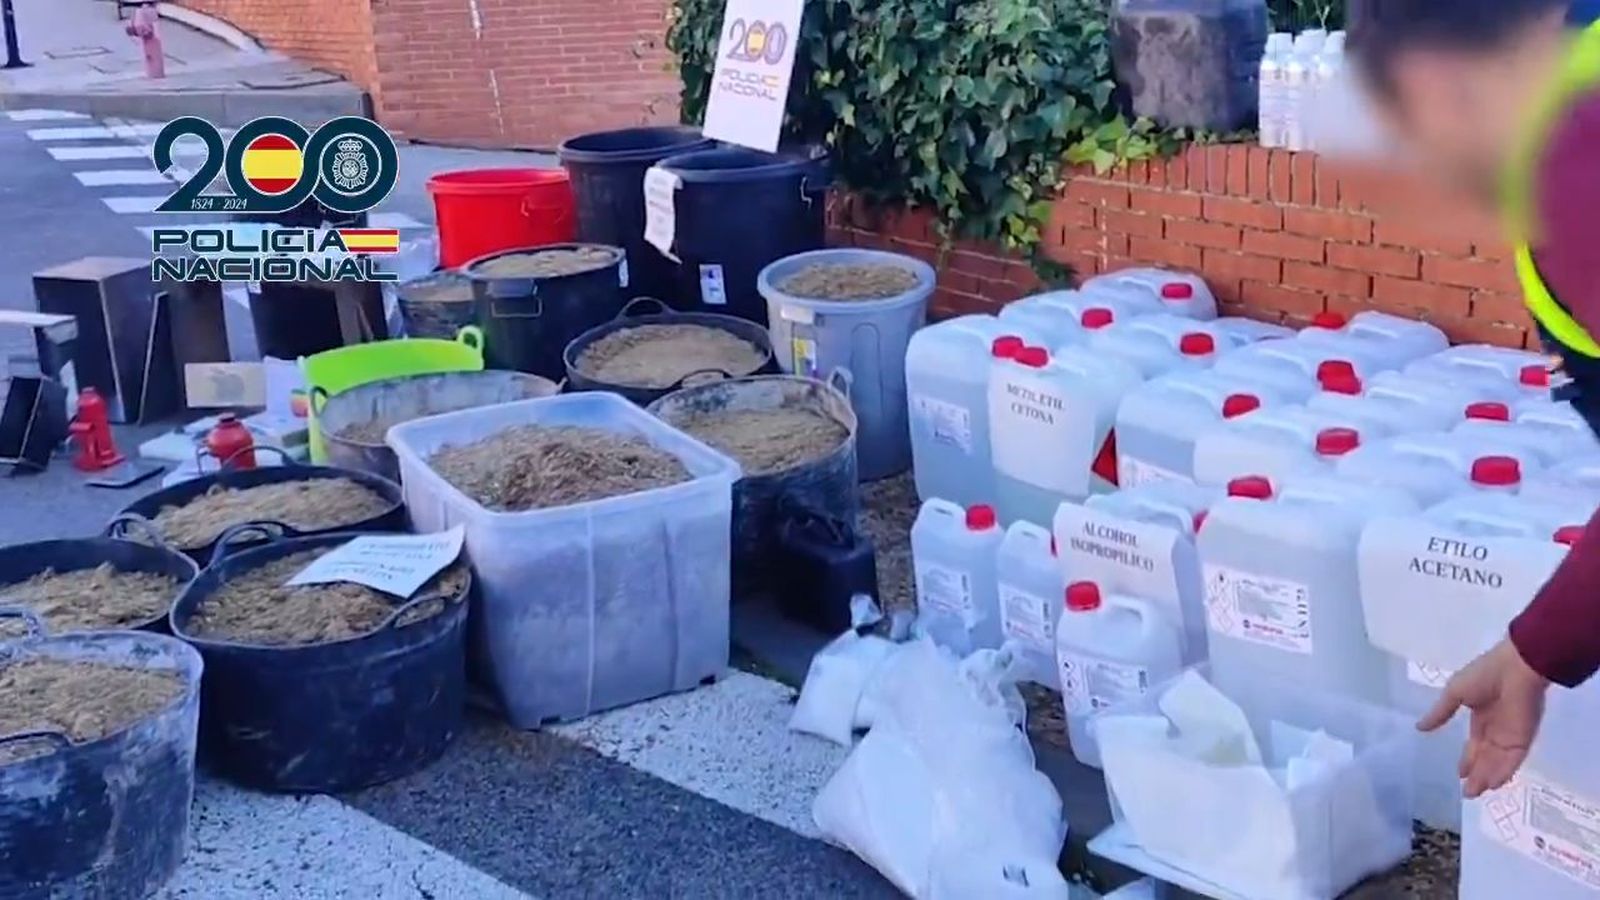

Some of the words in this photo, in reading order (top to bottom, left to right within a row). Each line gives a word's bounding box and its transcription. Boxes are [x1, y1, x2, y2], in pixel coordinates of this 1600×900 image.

[726, 17, 787, 65] 200
[1083, 521, 1139, 548] ALCOHOL
[1427, 536, 1488, 561] ETILO
[1408, 557, 1503, 588] ACETANO
